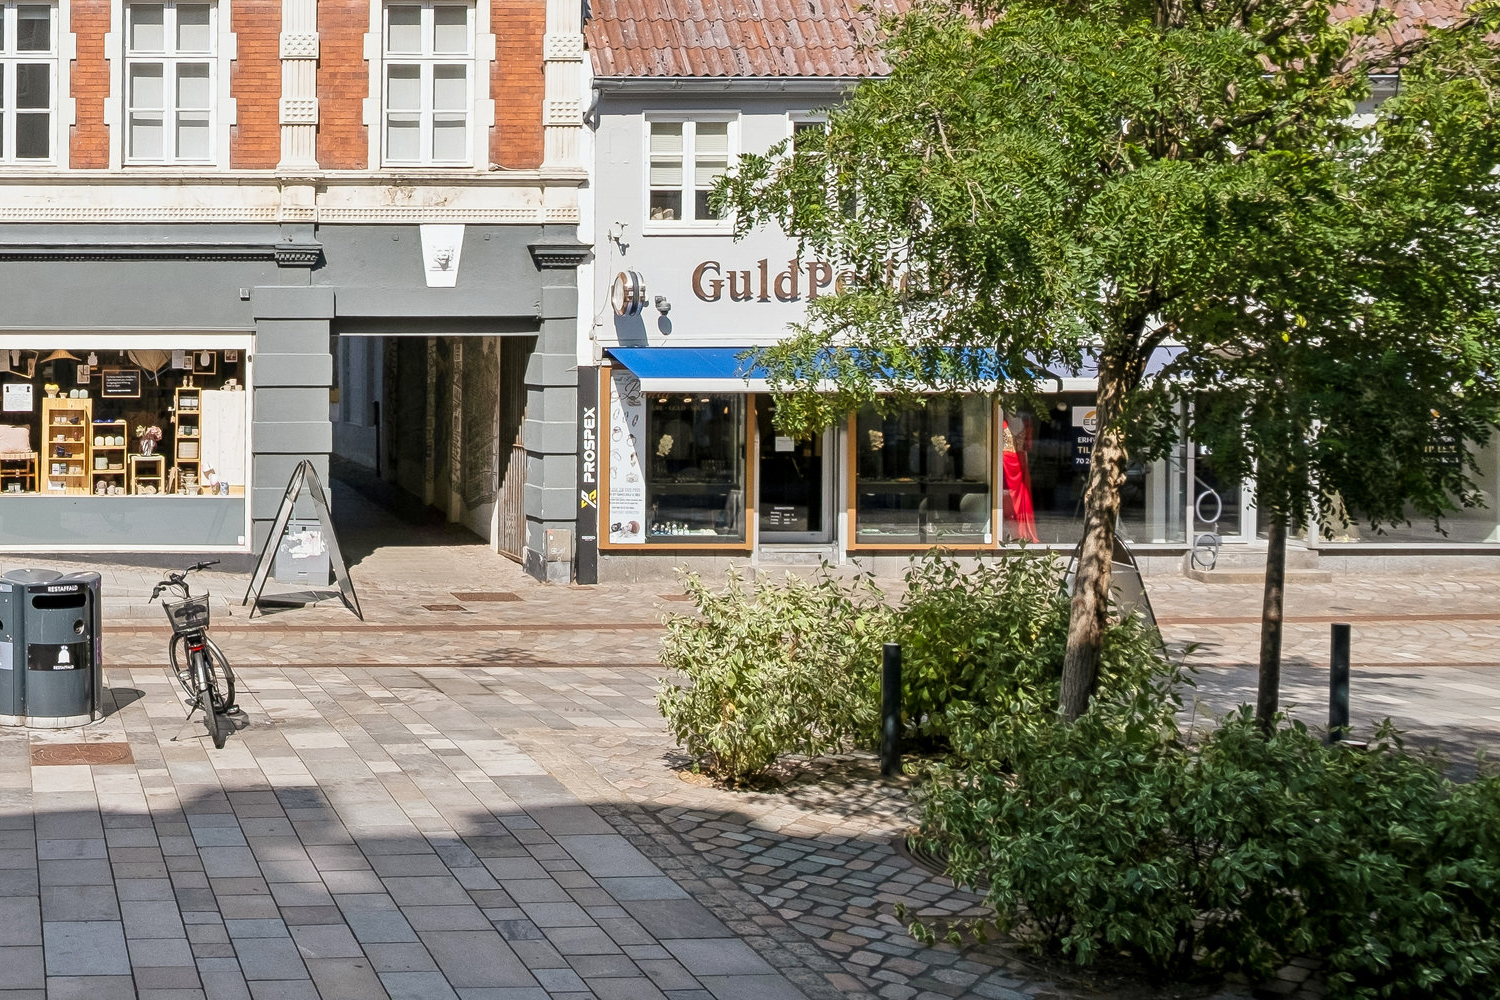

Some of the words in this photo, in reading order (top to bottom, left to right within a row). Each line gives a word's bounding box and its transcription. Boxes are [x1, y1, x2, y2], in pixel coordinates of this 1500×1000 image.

[691, 258, 955, 302] GuldPel
[1083, 418, 1098, 426] ED
[583, 407, 596, 483] PROSPEX
[47, 585, 79, 593] RESTAFFALD
